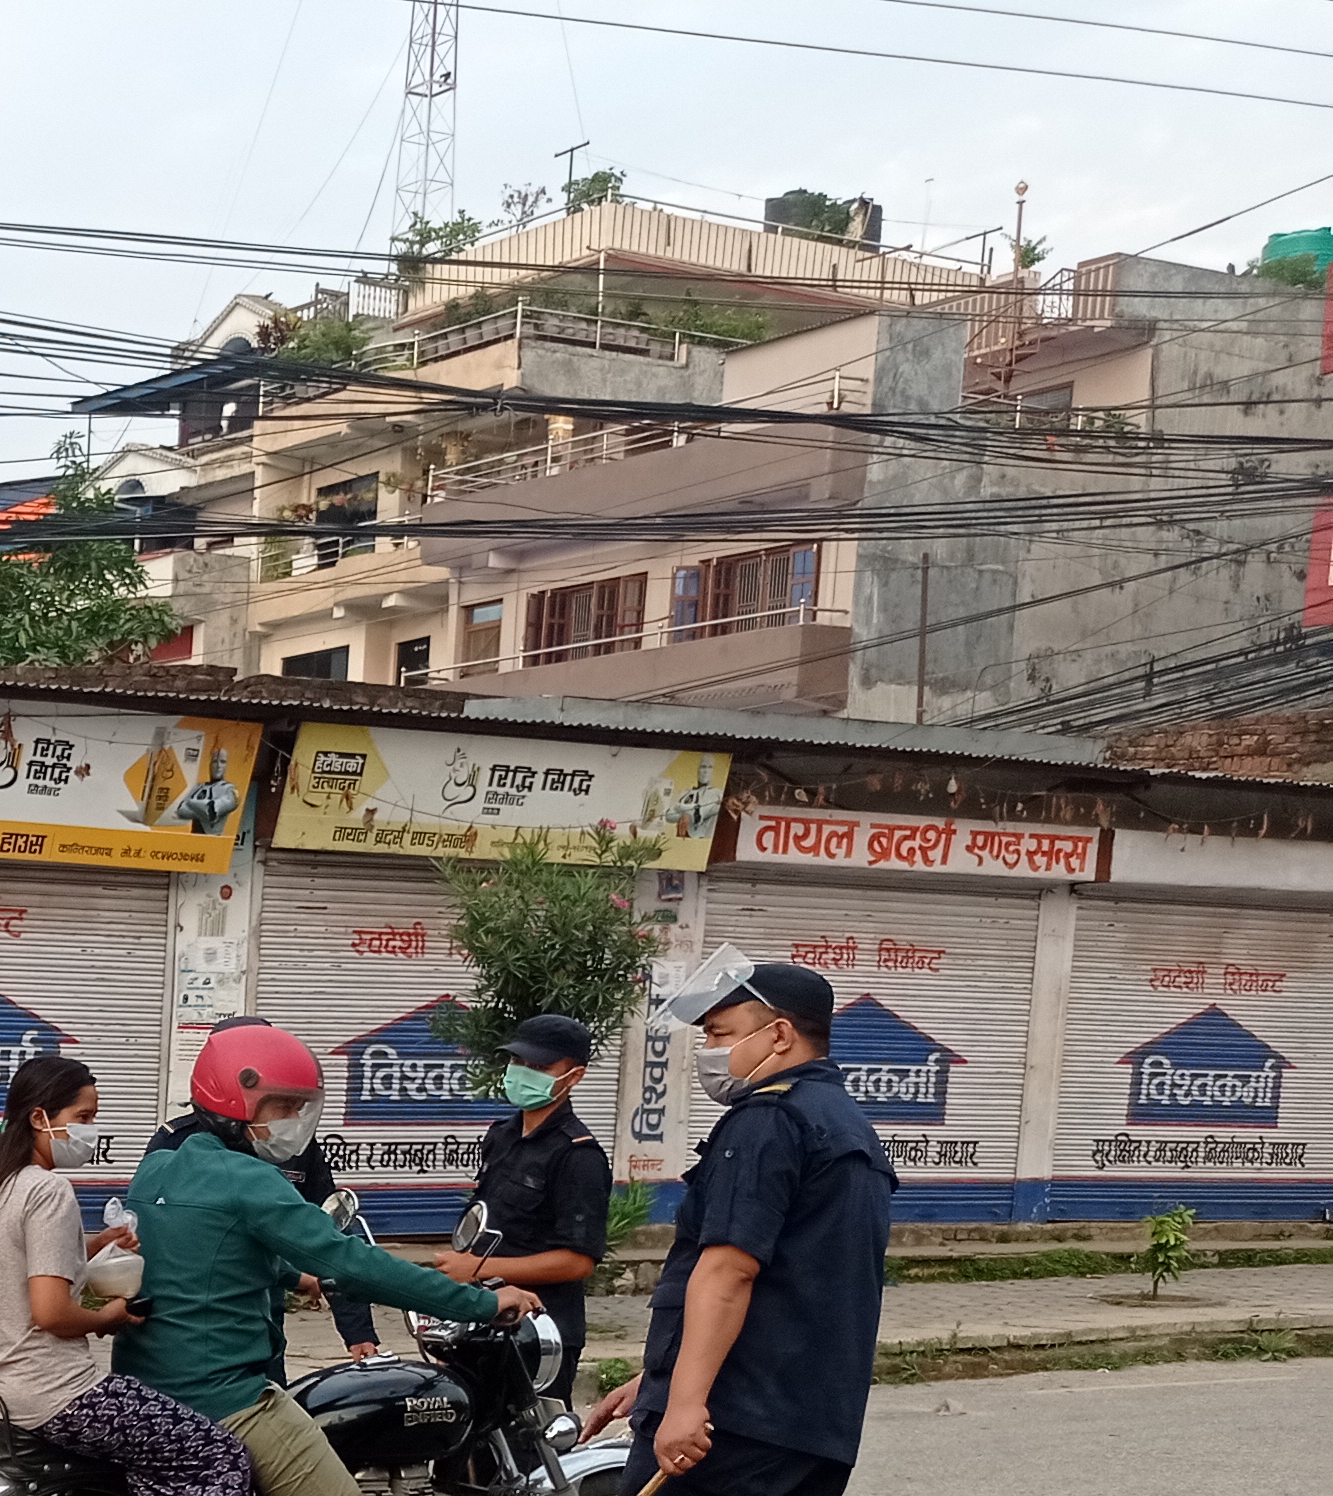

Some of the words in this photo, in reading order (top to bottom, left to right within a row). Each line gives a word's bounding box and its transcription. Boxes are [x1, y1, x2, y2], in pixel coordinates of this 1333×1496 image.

[755, 813, 860, 861] तायल
[965, 829, 1023, 870] एण्ड
[1025, 833, 1093, 875] सन्स
[351, 921, 427, 959] स्वदेशी
[791, 935, 859, 969] स्वदेशी
[1138, 1054, 1276, 1107] विश्वकर्मा
[405, 1396, 452, 1412] ROYAL
